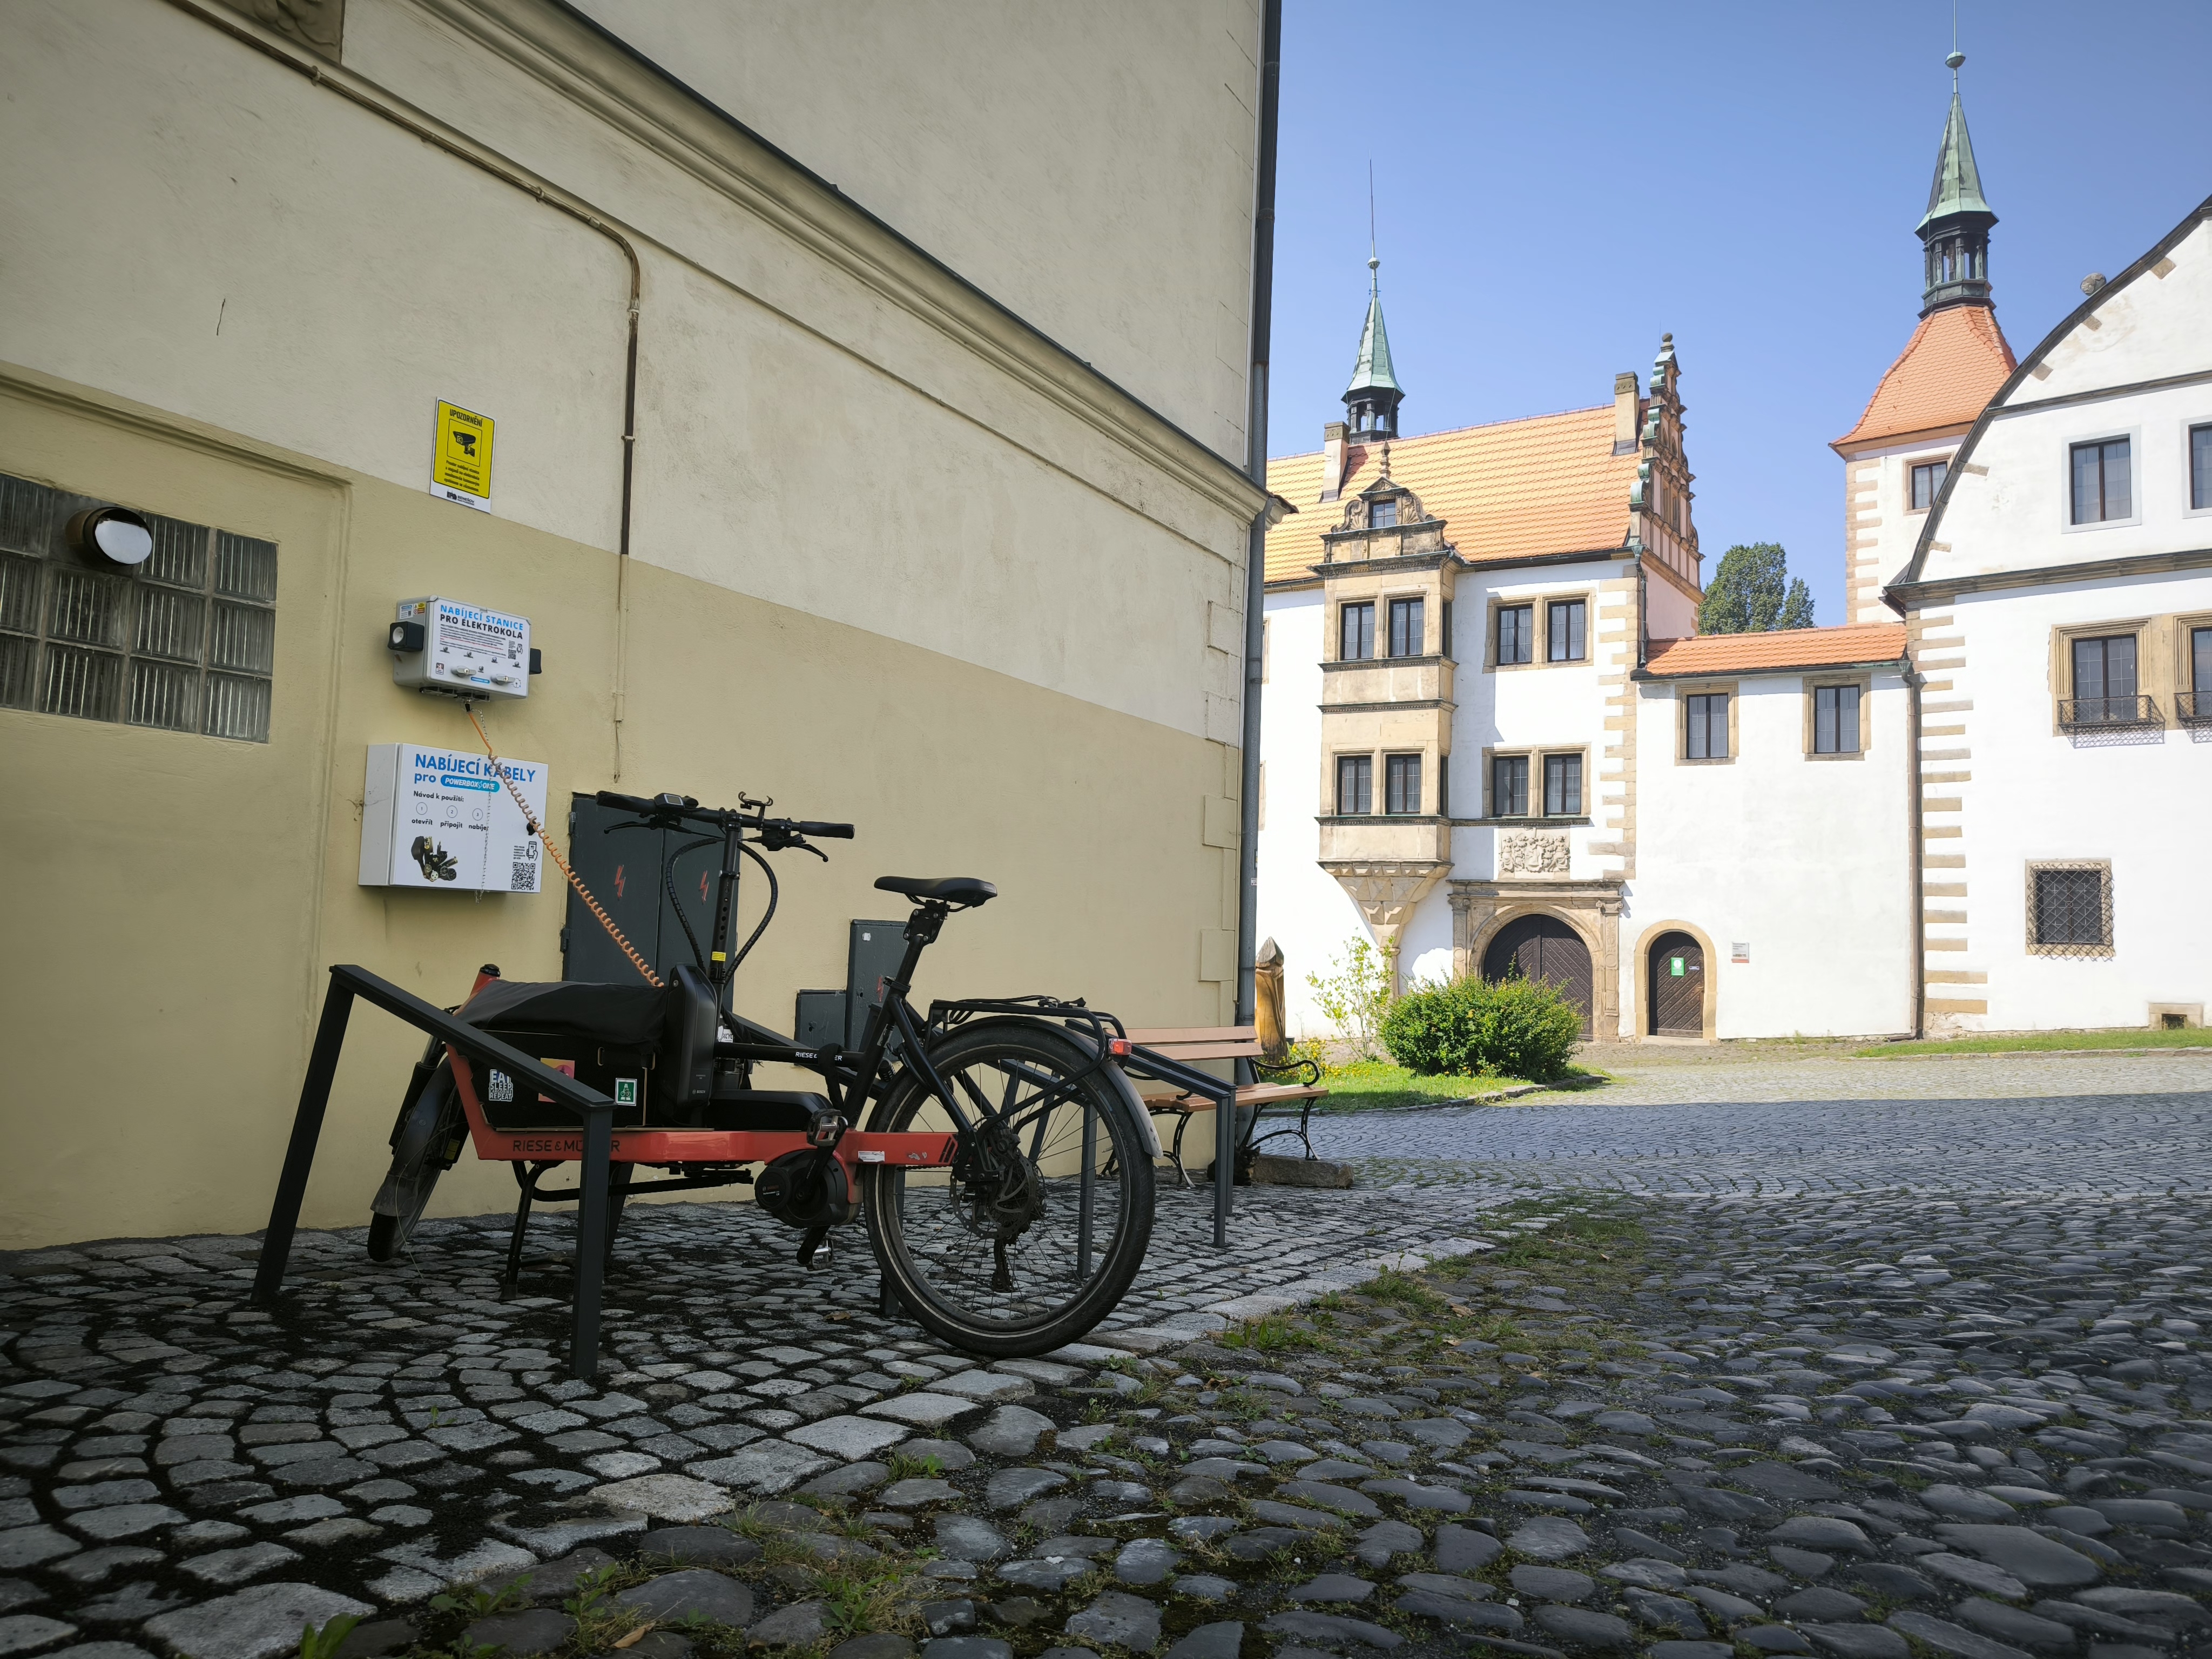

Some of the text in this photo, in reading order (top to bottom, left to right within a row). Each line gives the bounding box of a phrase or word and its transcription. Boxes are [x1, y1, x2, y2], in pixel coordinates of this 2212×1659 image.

[449, 408, 483, 427] UPOZORNĚNÍ
[440, 604, 483, 621] NABÍJECÍ
[485, 615, 523, 630] STANICE
[440, 613, 458, 624] PRO
[462, 618, 523, 639] ELEKTROKOLA
[415, 754, 536, 782] NABÍJECÍ KABELY
[414, 773, 436, 784] pro
[444, 777, 478, 787] POWERBOX
[414, 791, 434, 799] Návod
[440, 821, 463, 829] připojit
[513, 1140, 552, 1152] RIESE
